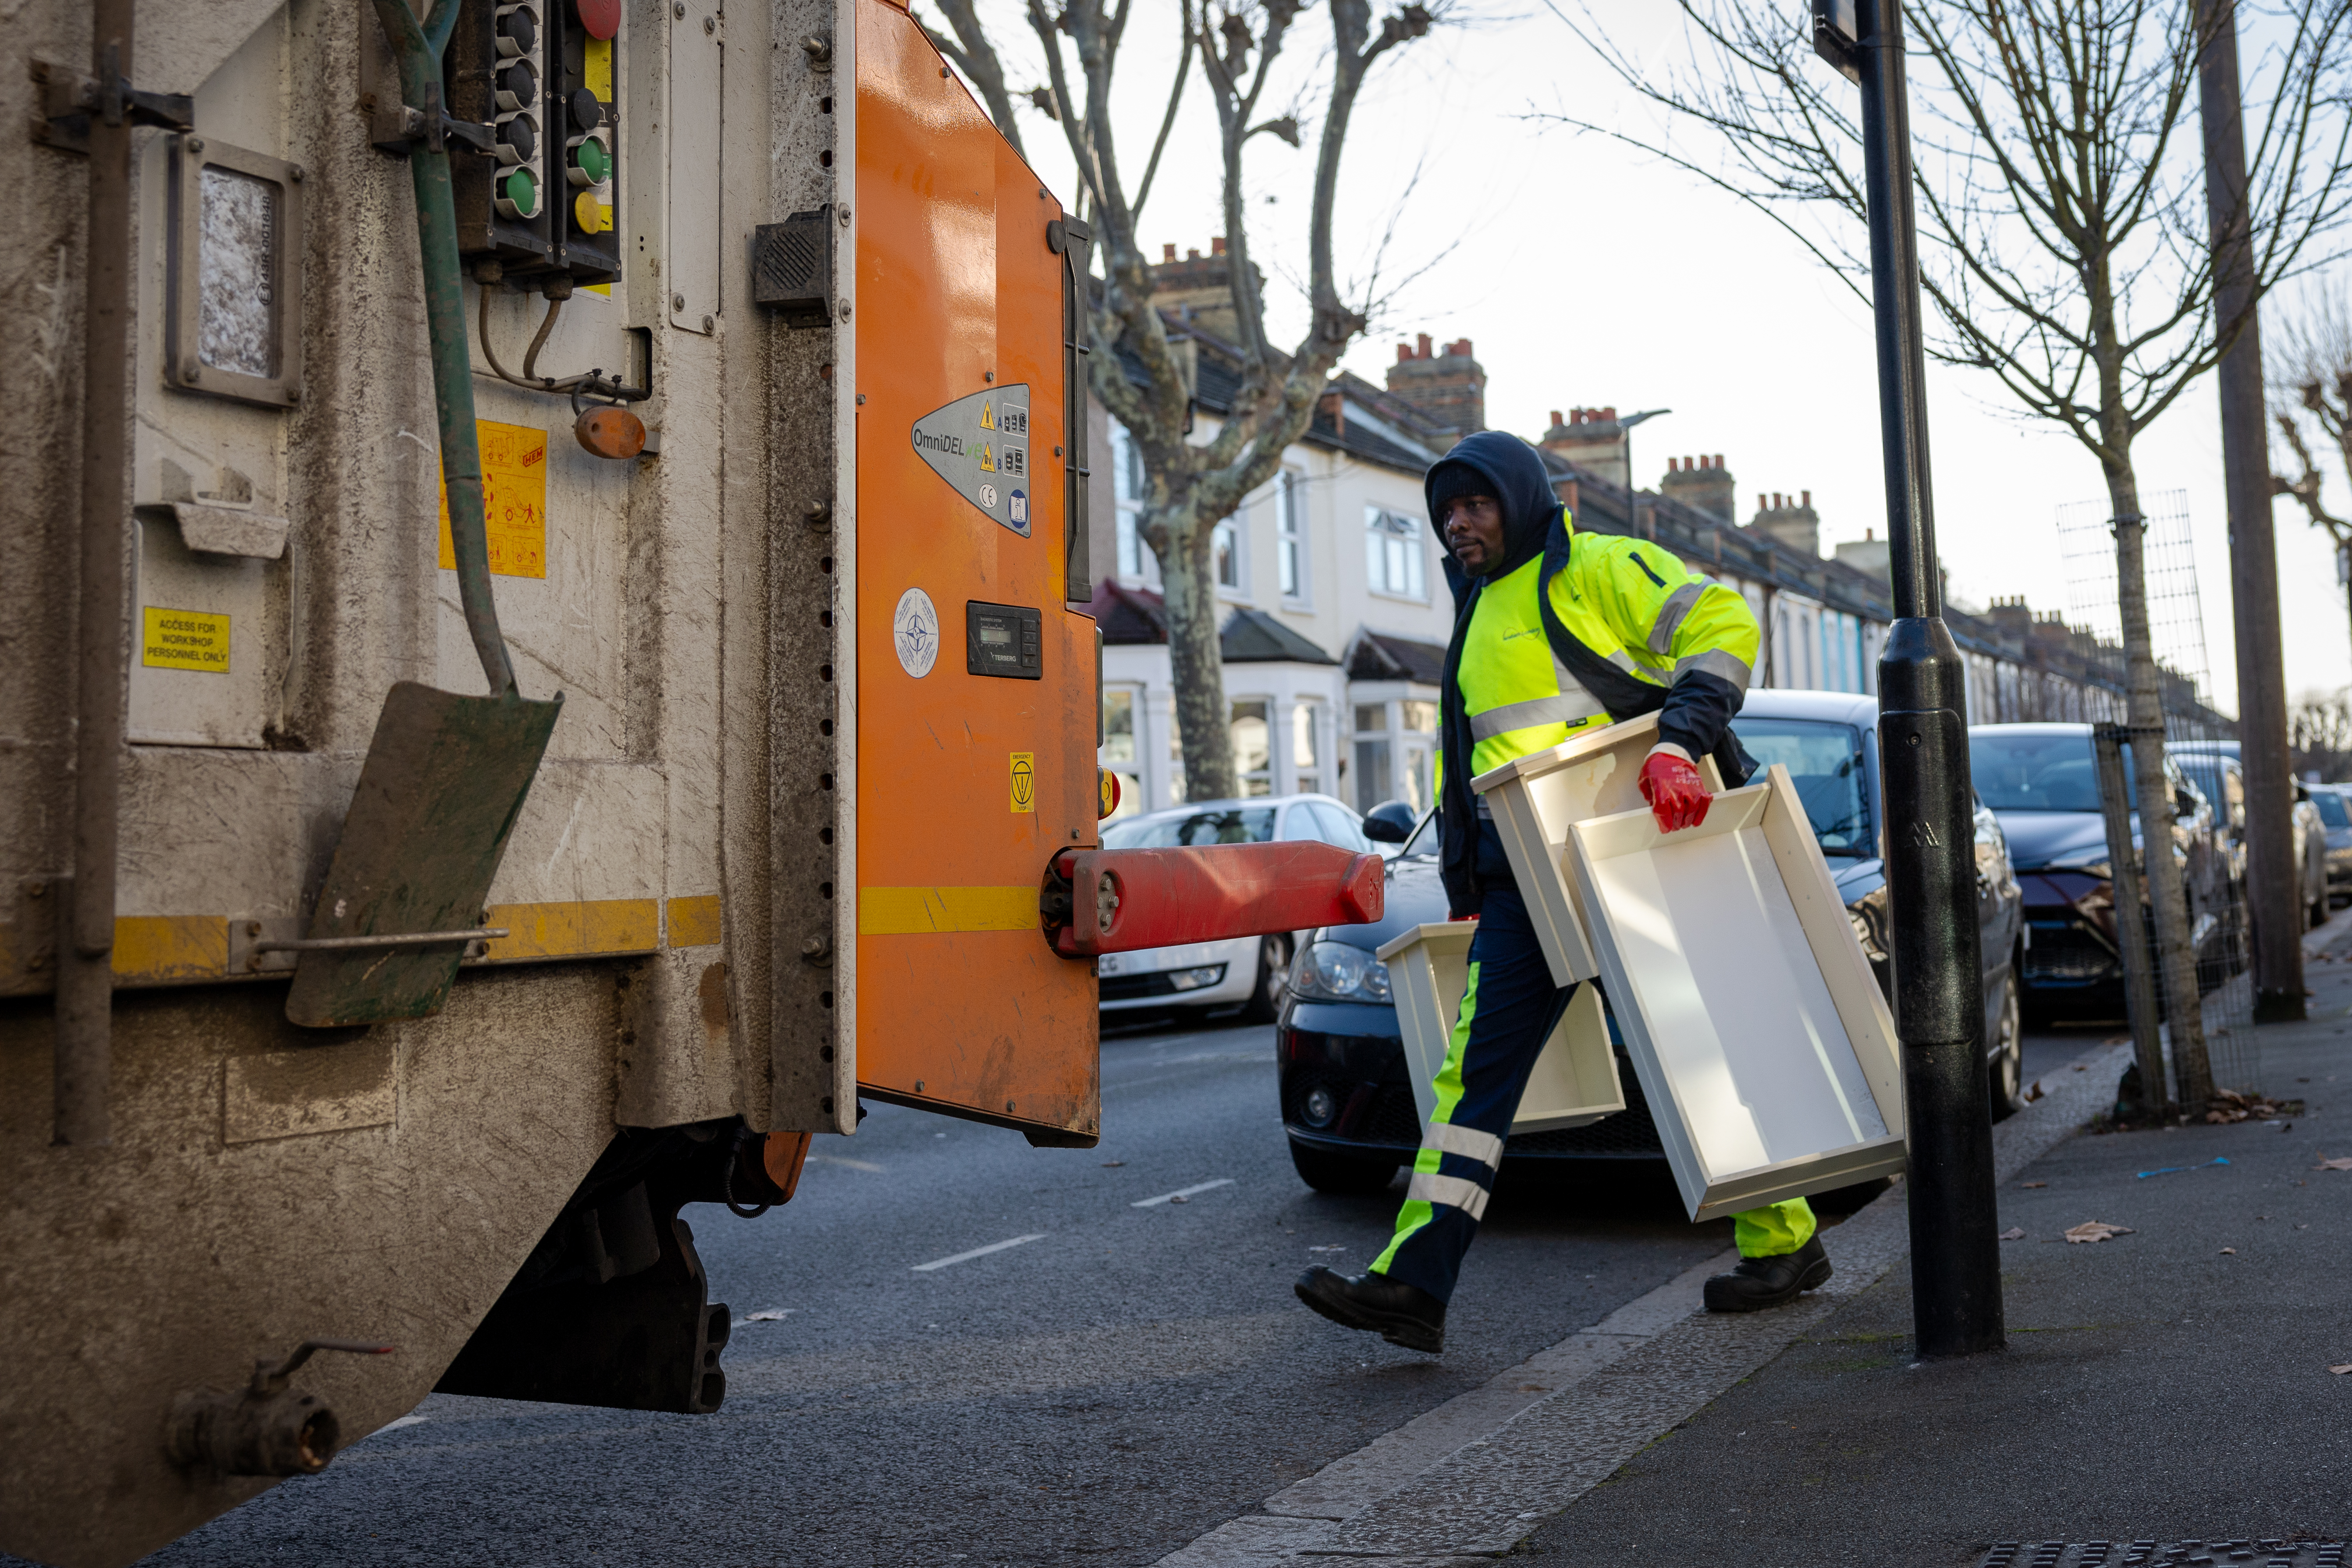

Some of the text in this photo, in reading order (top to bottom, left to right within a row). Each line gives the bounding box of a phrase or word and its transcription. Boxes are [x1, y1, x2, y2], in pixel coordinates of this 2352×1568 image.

[998, 417, 1002, 428] A
[998, 458, 1002, 469] B
[160, 619, 216, 633] ACCESS FOR
[162, 634, 213, 647] WORKSHOP
[147, 647, 226, 662] PERSONNEL ONLY
